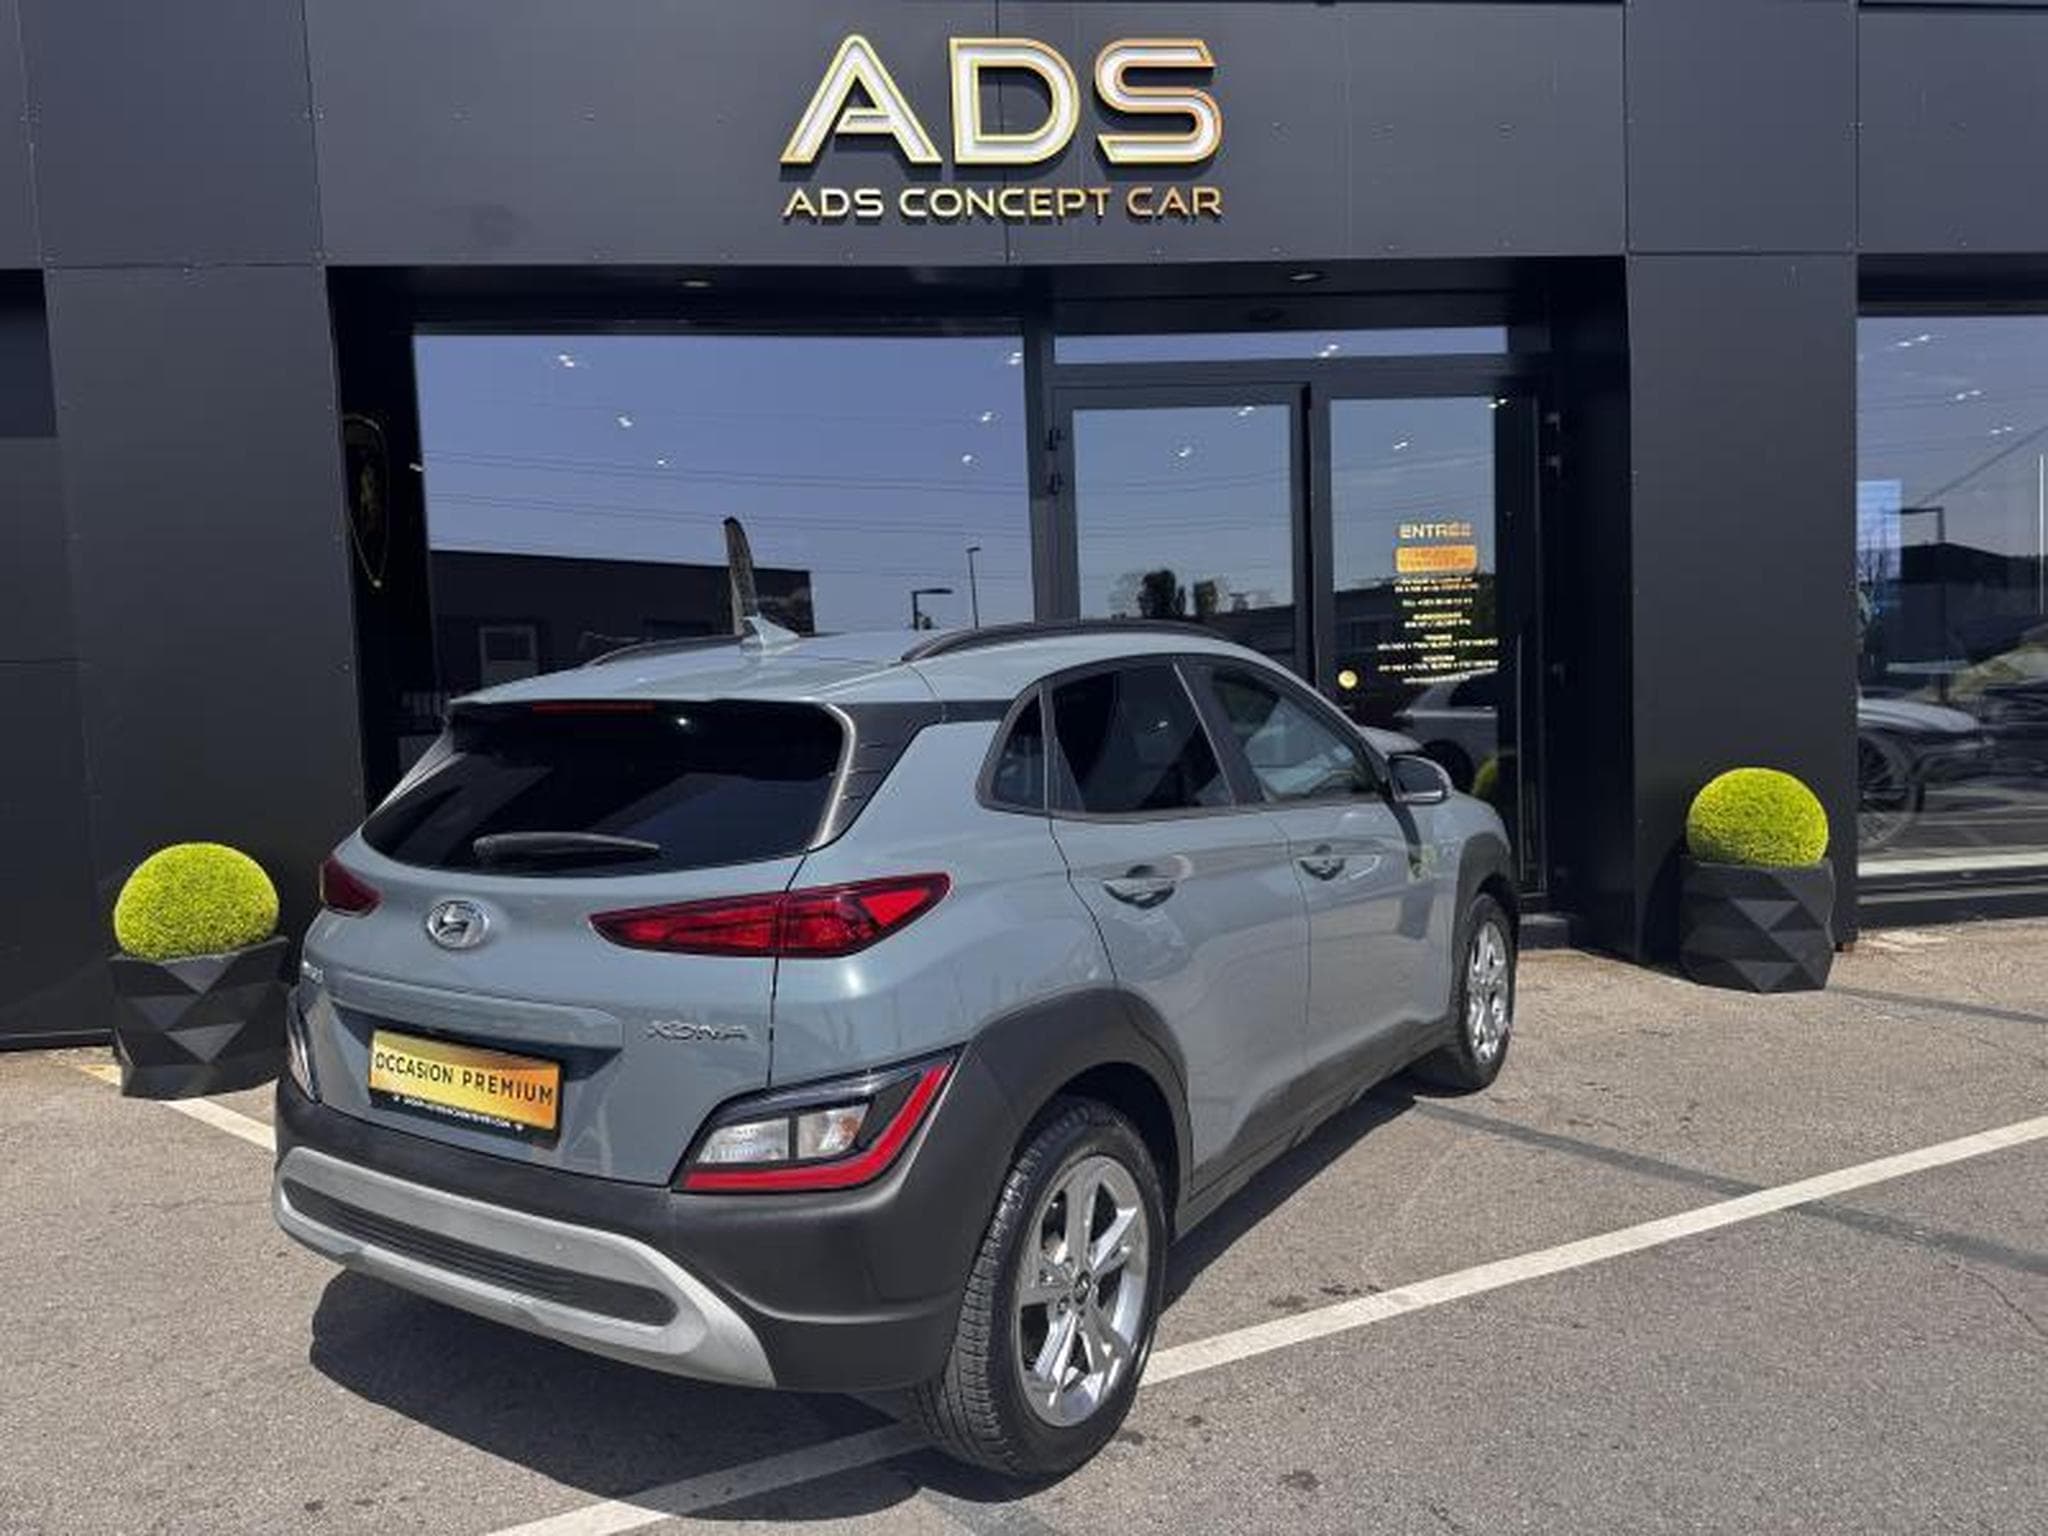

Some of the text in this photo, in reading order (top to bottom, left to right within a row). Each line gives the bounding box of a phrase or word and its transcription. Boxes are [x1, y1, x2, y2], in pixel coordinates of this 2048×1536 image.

[779, 33, 1223, 164] ADS
[783, 186, 1224, 218] ADS CONCEPT CAR
[375, 1051, 554, 1106] OCCASION PREMIUM
